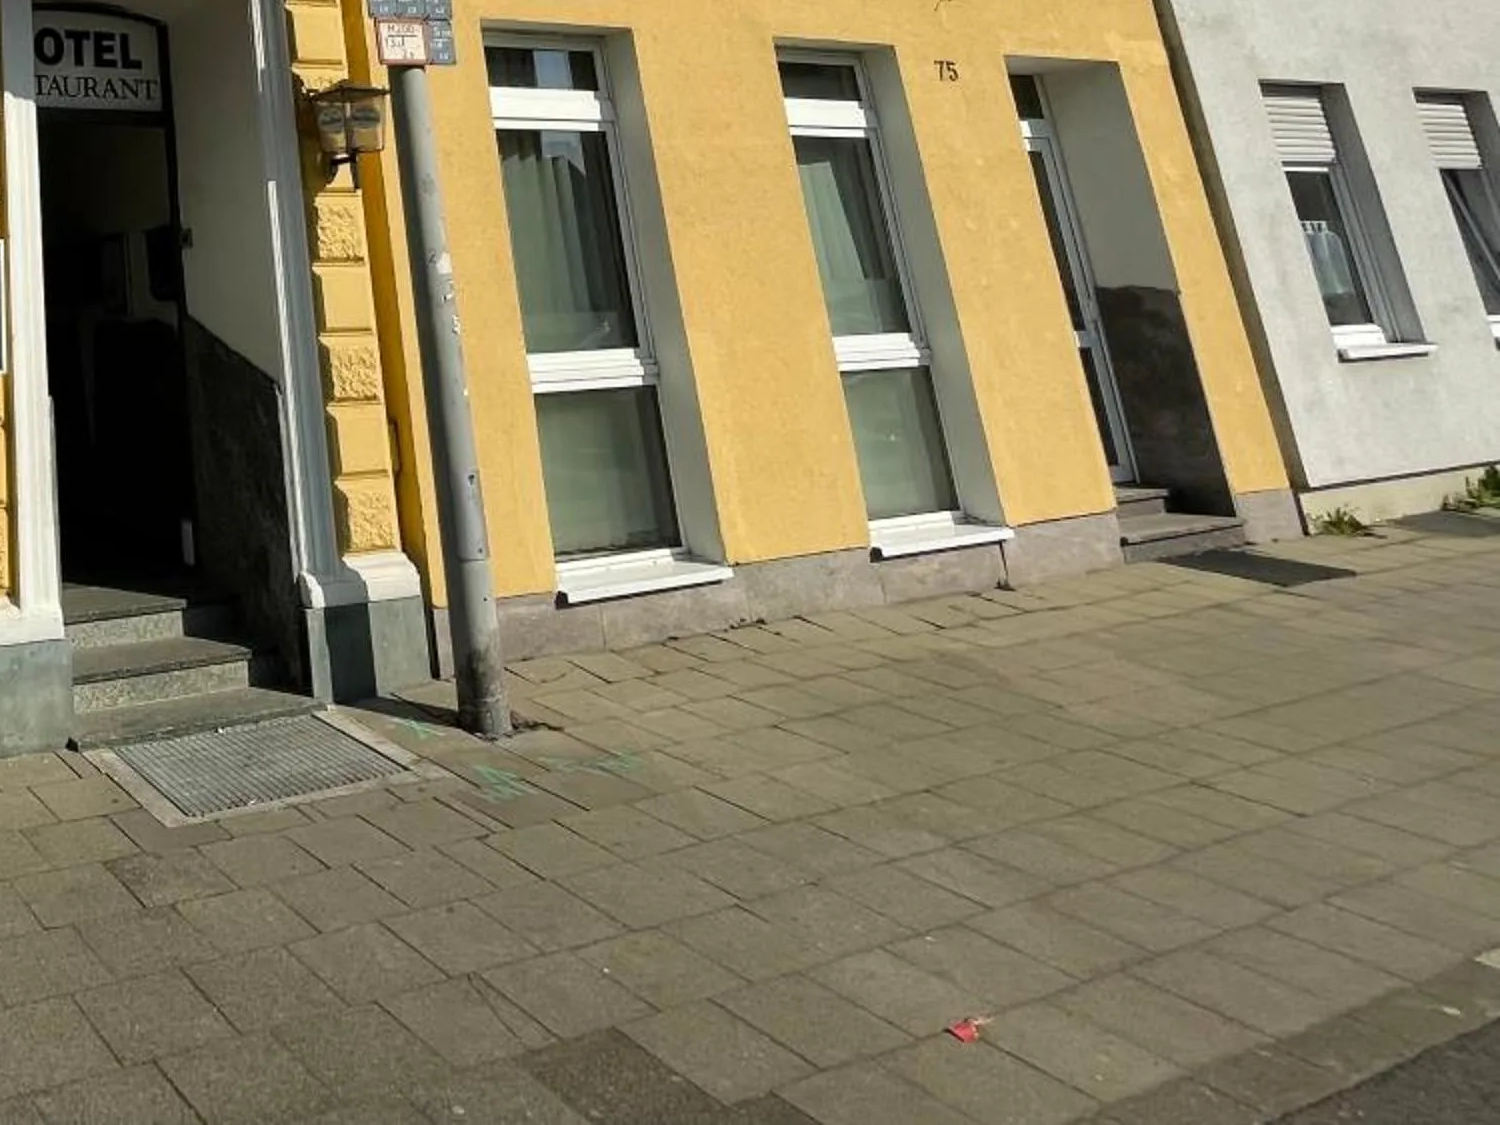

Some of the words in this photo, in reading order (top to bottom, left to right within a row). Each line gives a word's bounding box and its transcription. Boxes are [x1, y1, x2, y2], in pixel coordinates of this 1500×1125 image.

[33, 27, 143, 69] OTEL
[933, 60, 959, 82] 75
[35, 75, 159, 101] TAURANT
